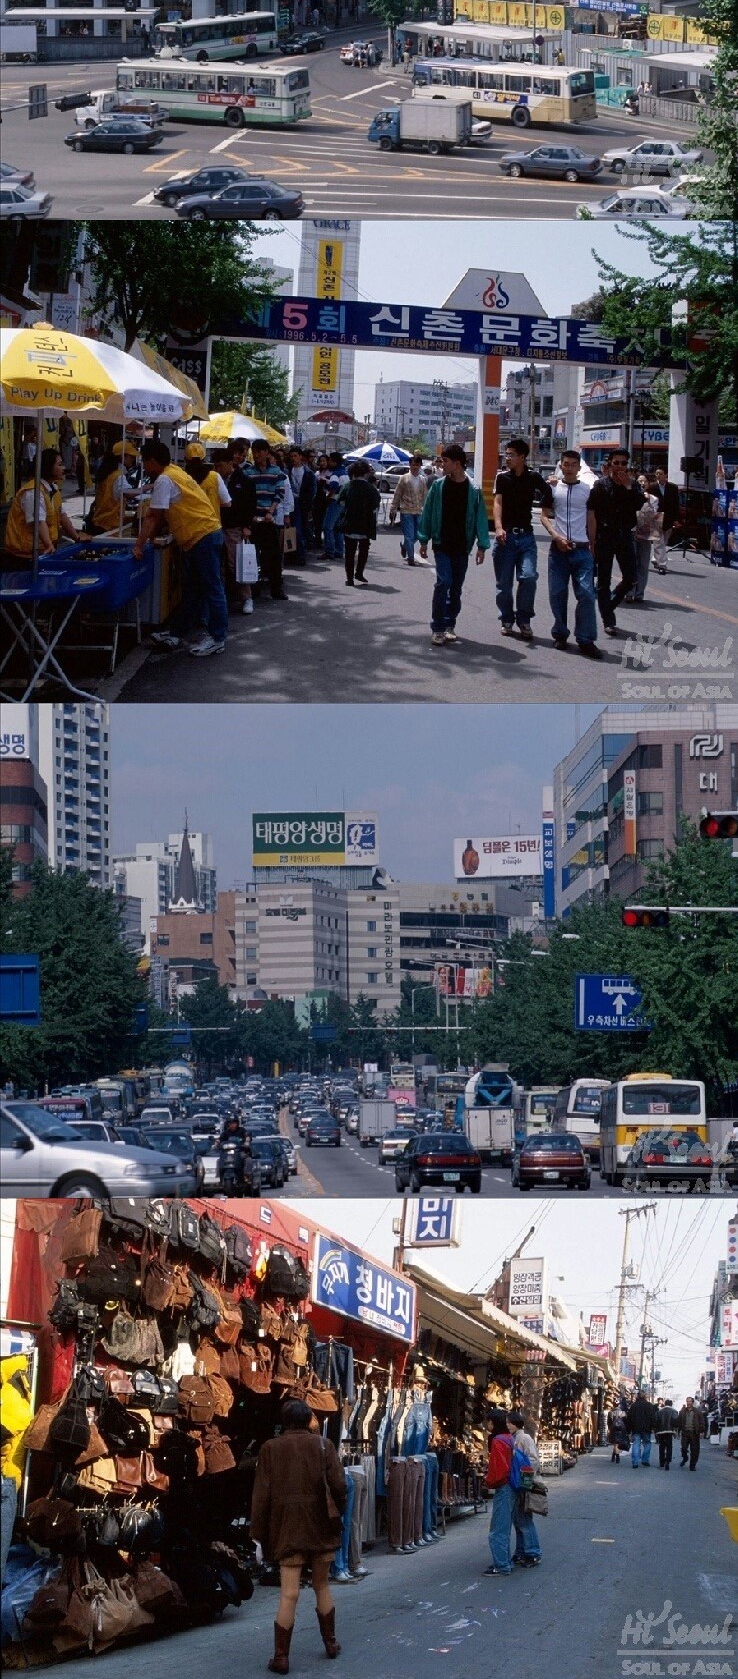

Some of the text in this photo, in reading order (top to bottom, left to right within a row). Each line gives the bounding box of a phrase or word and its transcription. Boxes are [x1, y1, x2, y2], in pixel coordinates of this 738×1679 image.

[10, 387, 102, 404] Play Up Drink
[255, 820, 344, 846] 태평양생명
[482, 839, 512, 854] 딤플은
[544, 826, 555, 870] 교보생명
[587, 1014, 619, 1028] 우측차선
[355, 1264, 411, 1325] 청바지
